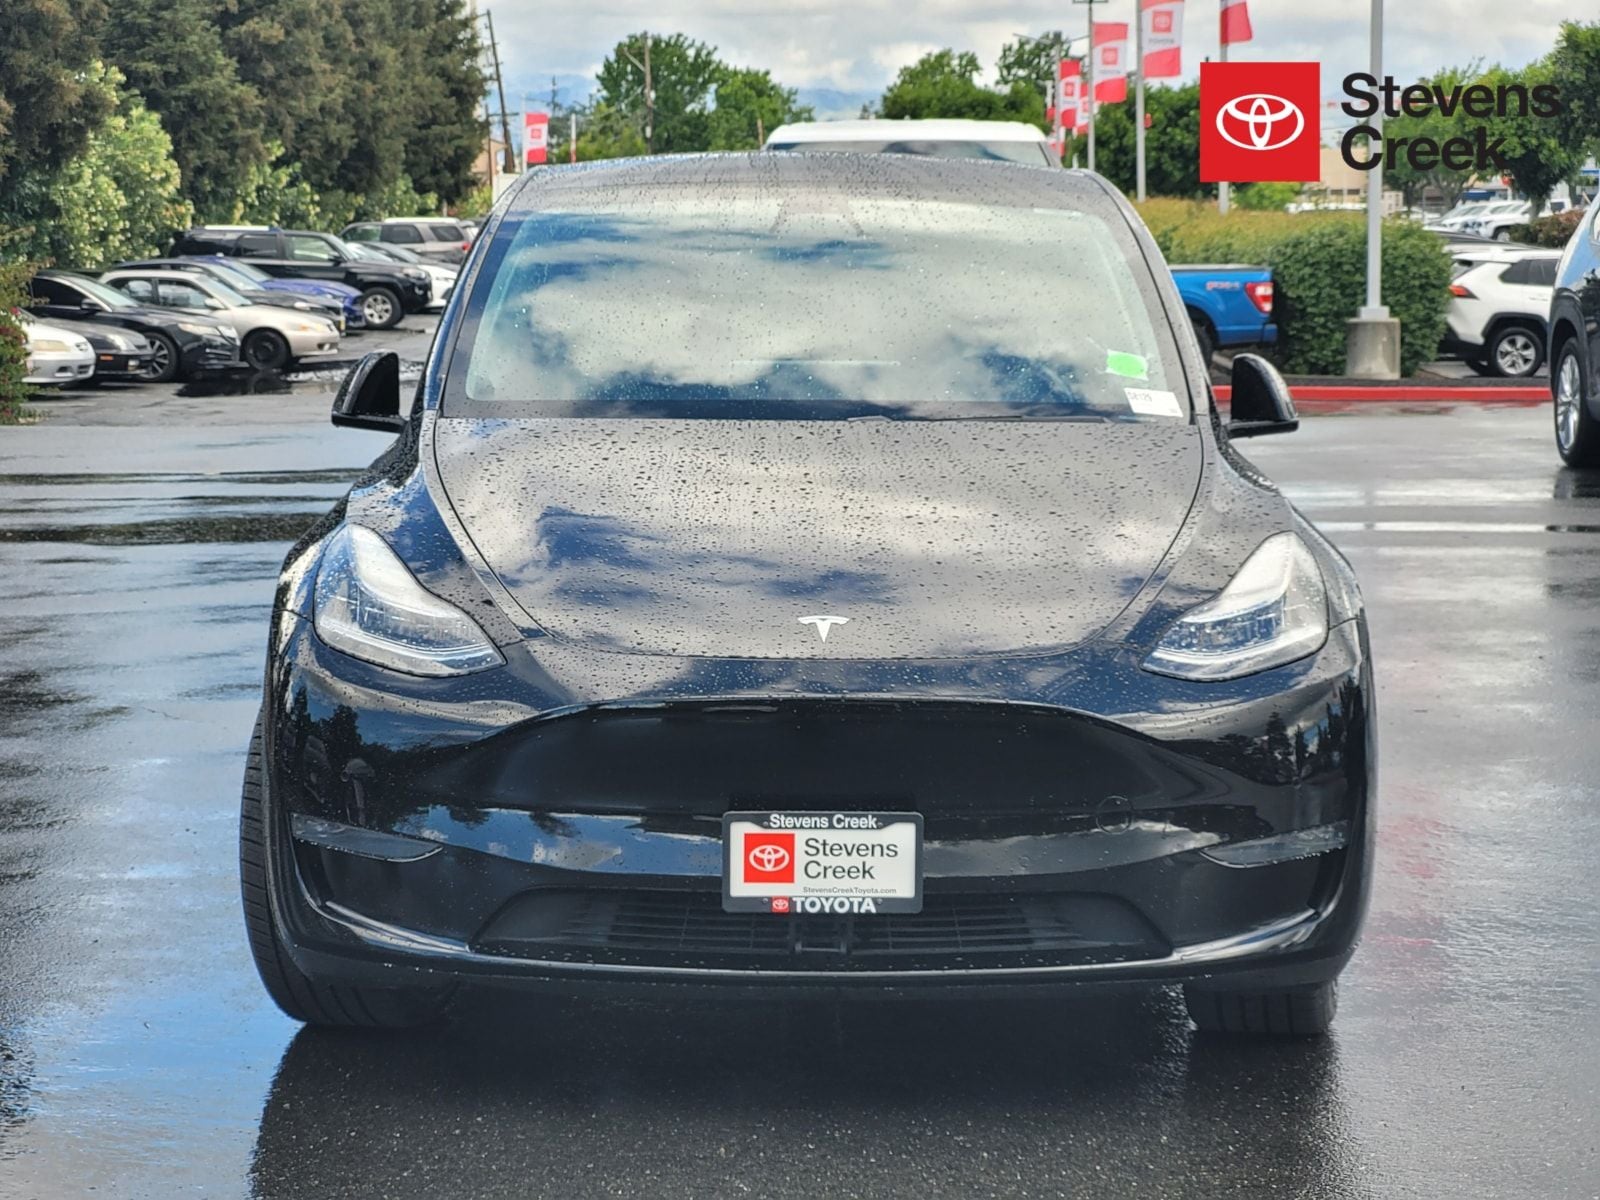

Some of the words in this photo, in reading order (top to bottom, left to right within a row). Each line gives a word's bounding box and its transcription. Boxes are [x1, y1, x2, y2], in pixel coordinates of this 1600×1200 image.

[769, 814, 828, 829] Stevens
[832, 814, 877, 829] Creek
[804, 838, 898, 858] Stevens
[804, 860, 875, 880] Creek
[792, 897, 876, 914] TOYOTA
